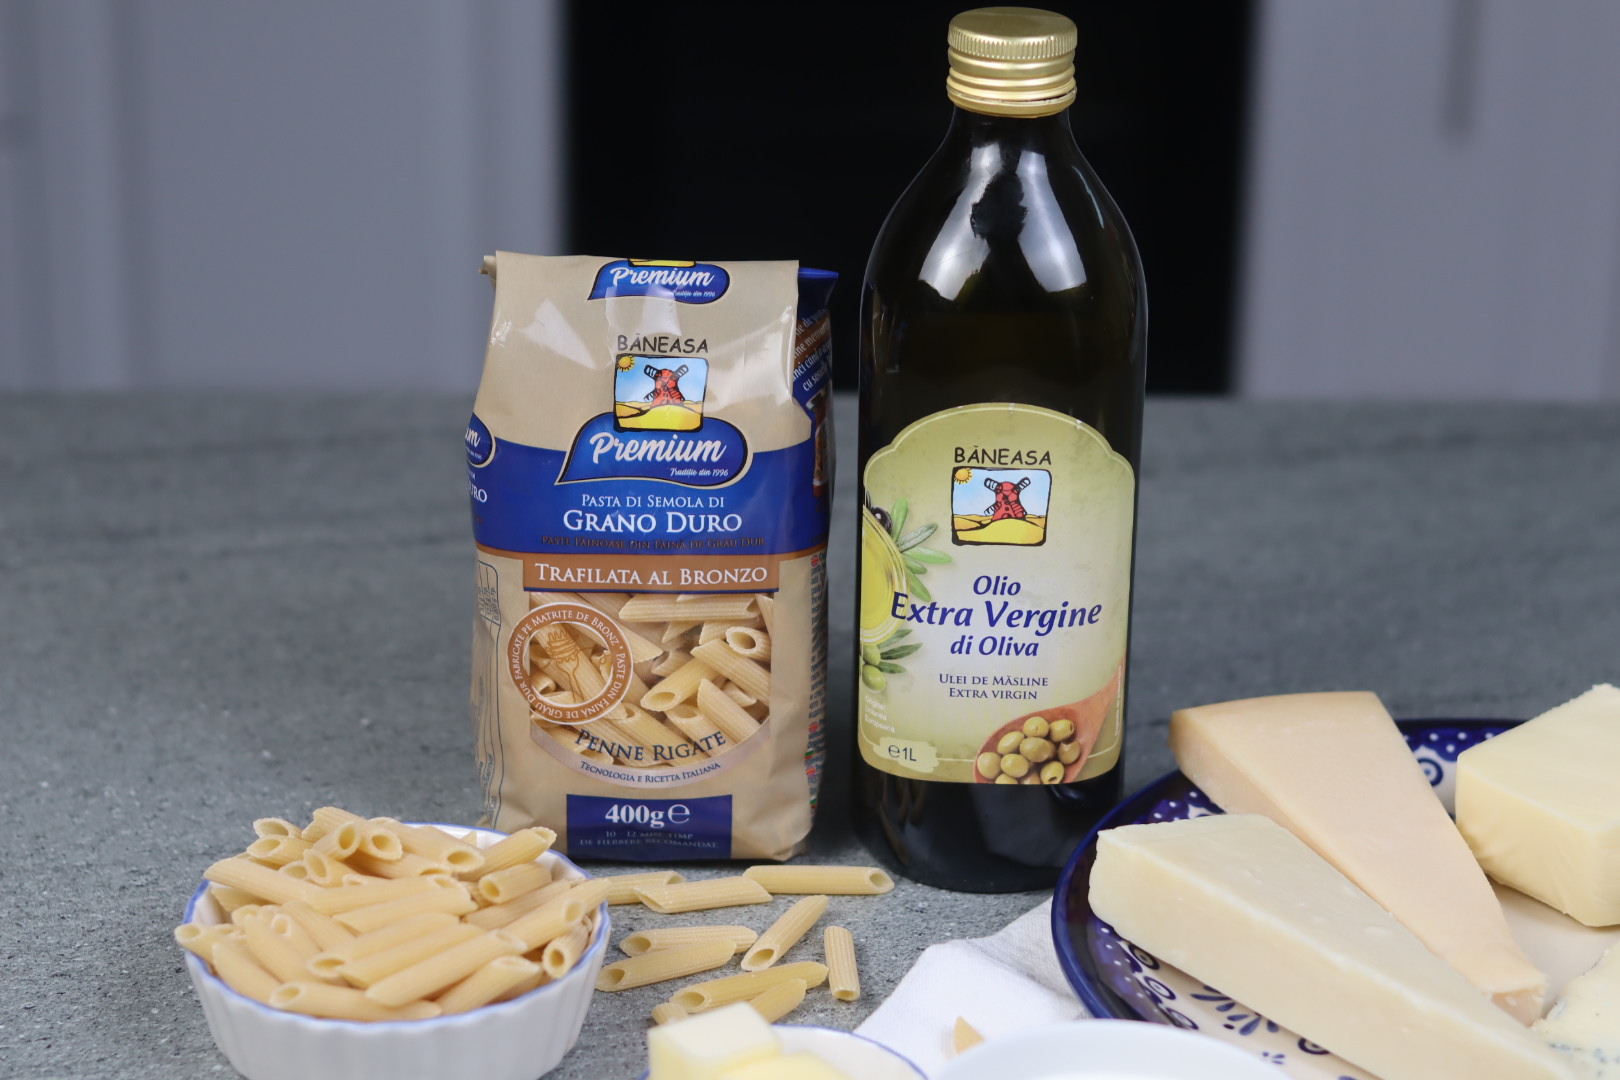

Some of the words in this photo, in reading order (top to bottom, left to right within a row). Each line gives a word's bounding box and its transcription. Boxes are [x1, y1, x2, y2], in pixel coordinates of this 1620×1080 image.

[609, 267, 715, 287] Premium
[617, 332, 709, 354] BĂNEASA
[589, 431, 728, 464] Premium
[954, 445, 1052, 466] BĂNEASA
[698, 468, 711, 476] din
[712, 468, 729, 477] 1996
[581, 494, 622, 507] PASTA
[626, 496, 642, 507] DI
[647, 494, 704, 508] SEMOLA
[708, 496, 725, 508] DI
[563, 509, 656, 533] GRANO
[666, 511, 743, 533] DURO
[534, 562, 643, 585] TRAFILATA
[647, 570, 673, 586] AL
[679, 566, 769, 586] BRONZO
[973, 575, 1021, 596] Olio
[575, 611, 590, 622] DE
[890, 591, 974, 627] Extra
[984, 600, 1103, 637] Vergine
[521, 623, 533, 635] PE
[591, 616, 620, 646] BRONZ
[512, 632, 525, 680] FABRICATE
[949, 634, 974, 655] di
[978, 635, 1040, 657] Oliva
[616, 652, 627, 680] PASTE
[606, 681, 622, 700] DIN
[939, 673, 967, 685] ULEI
[971, 676, 989, 686] DE
[991, 674, 1049, 687] MĂSLINE
[519, 681, 536, 704] DUR
[949, 687, 988, 699] EXTRA
[991, 690, 1038, 700] VIRGIN
[566, 710, 579, 719] DE
[574, 728, 644, 761] PENNE
[652, 730, 727, 761] RIGATE
[580, 760, 636, 782] TECNOLOGIA
[637, 775, 642, 783] E
[645, 774, 681, 783] RICETTA
[682, 762, 721, 780] ITALIANA
[604, 803, 665, 829] 400g
[605, 830, 617, 838] 10
